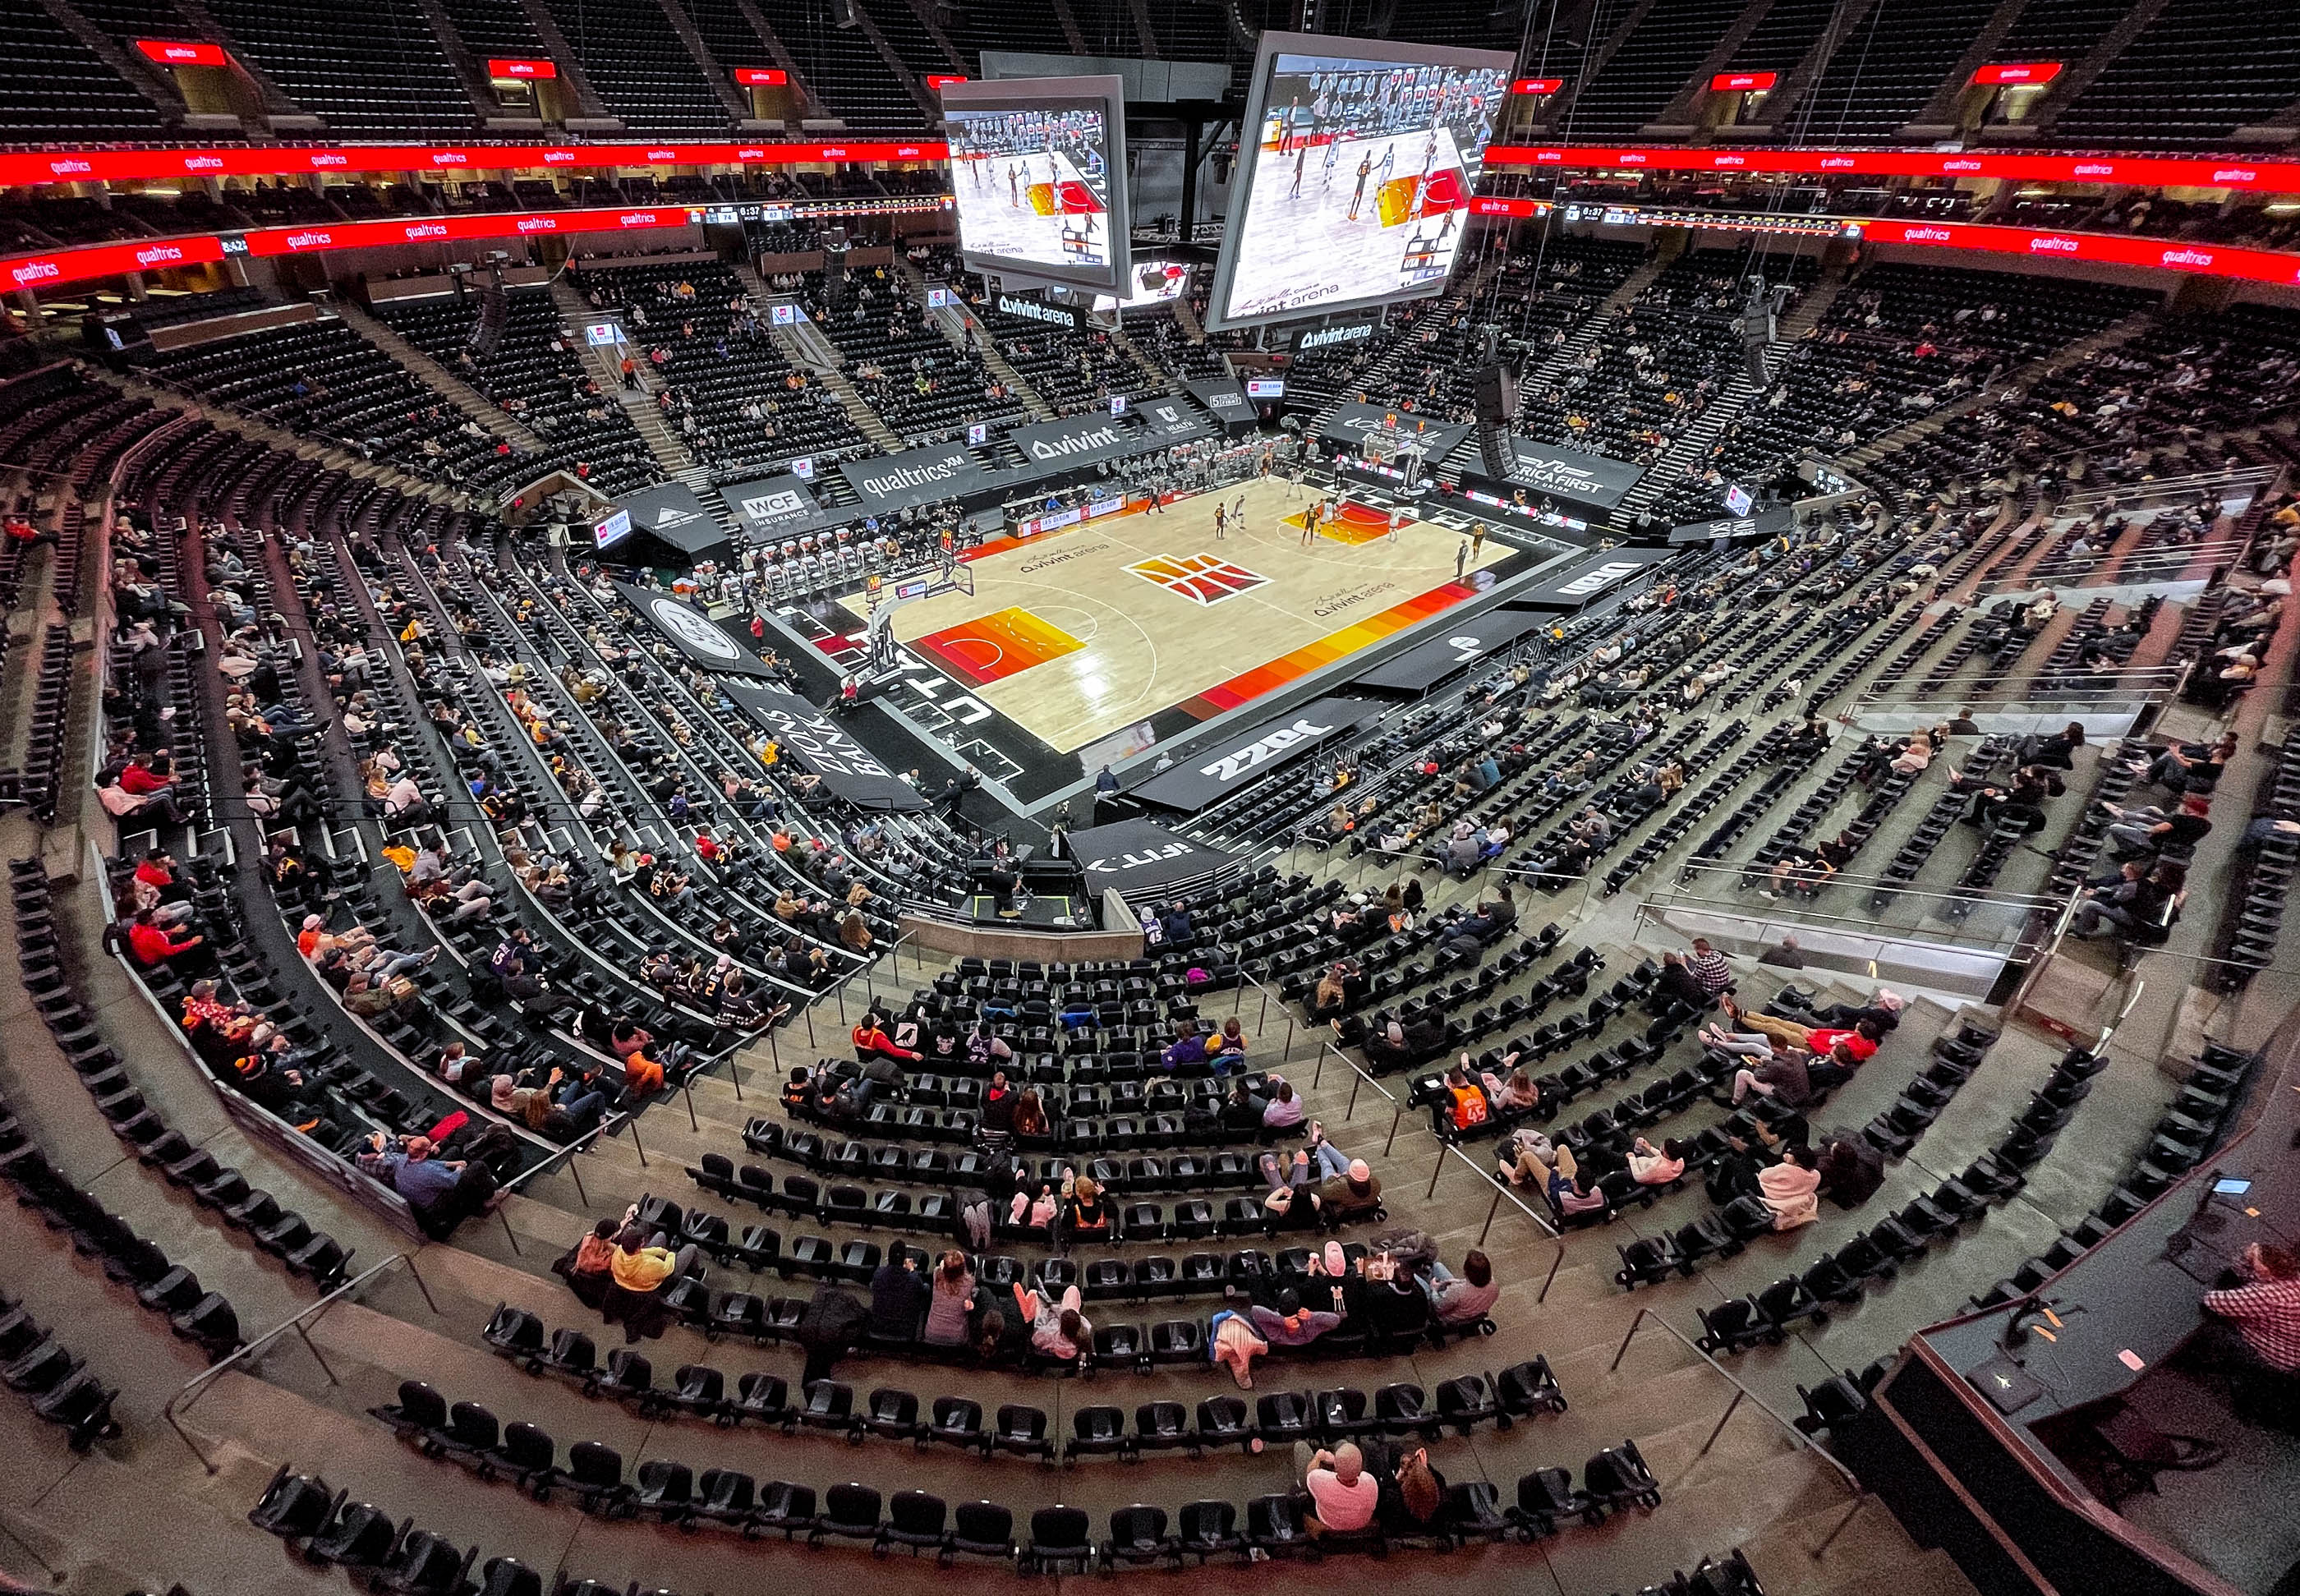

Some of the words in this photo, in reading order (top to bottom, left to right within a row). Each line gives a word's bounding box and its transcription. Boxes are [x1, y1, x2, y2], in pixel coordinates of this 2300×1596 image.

[166, 48, 197, 58] qualtrics
[434, 152, 467, 165] qualtrics
[545, 151, 575, 163] qualtrics
[648, 150, 675, 161] qualtrics
[739, 149, 764, 159] qualtrics
[823, 148, 846, 159] qualtrics
[899, 147, 919, 157] qualtrics
[1621, 154, 1646, 163] qualtrics
[51, 159, 91, 176] qualtrics
[186, 156, 223, 171] qualtrics
[311, 154, 347, 168] qualtrics
[1715, 156, 1745, 166] qualtrics
[1944, 159, 1981, 172] qualtrics
[2075, 163, 2113, 175] qualtrics
[2214, 169, 2256, 182] qualtrics
[518, 217, 556, 233] qualtrics
[621, 212, 656, 228] qualtrics
[406, 223, 448, 240] qualtrics
[1905, 227, 1951, 241] qualtrics
[288, 232, 332, 251] qualtrics
[2031, 237, 2079, 251] qualtrics
[137, 246, 182, 267] qualtrics
[2162, 249, 2213, 266] qualtrics
[13, 262, 59, 285] qualtrics
[1291, 284, 1339, 306] arena
[1010, 299, 1042, 319] vivint
[1042, 308, 1074, 326] arena
[1312, 327, 1345, 347] vivint
[1344, 324, 1372, 341] arena
[1212, 396, 1220, 406] 5
[1166, 421, 1194, 432] HEALTH
[1052, 426, 1120, 454] vivint
[1543, 482, 1570, 493] UNION
[1554, 474, 1604, 494] FIRST
[748, 494, 794, 514] WCF
[754, 508, 810, 527] INSURANCE
[1037, 554, 1075, 568] vivint
[1075, 544, 1109, 558] arena
[1327, 594, 1366, 613] vivint
[1362, 582, 1396, 599] arena
[757, 706, 854, 776] ZIONS
[794, 712, 893, 779] BANK
[705, 981, 716, 996] 2
[1467, 1105, 1486, 1123] 45
